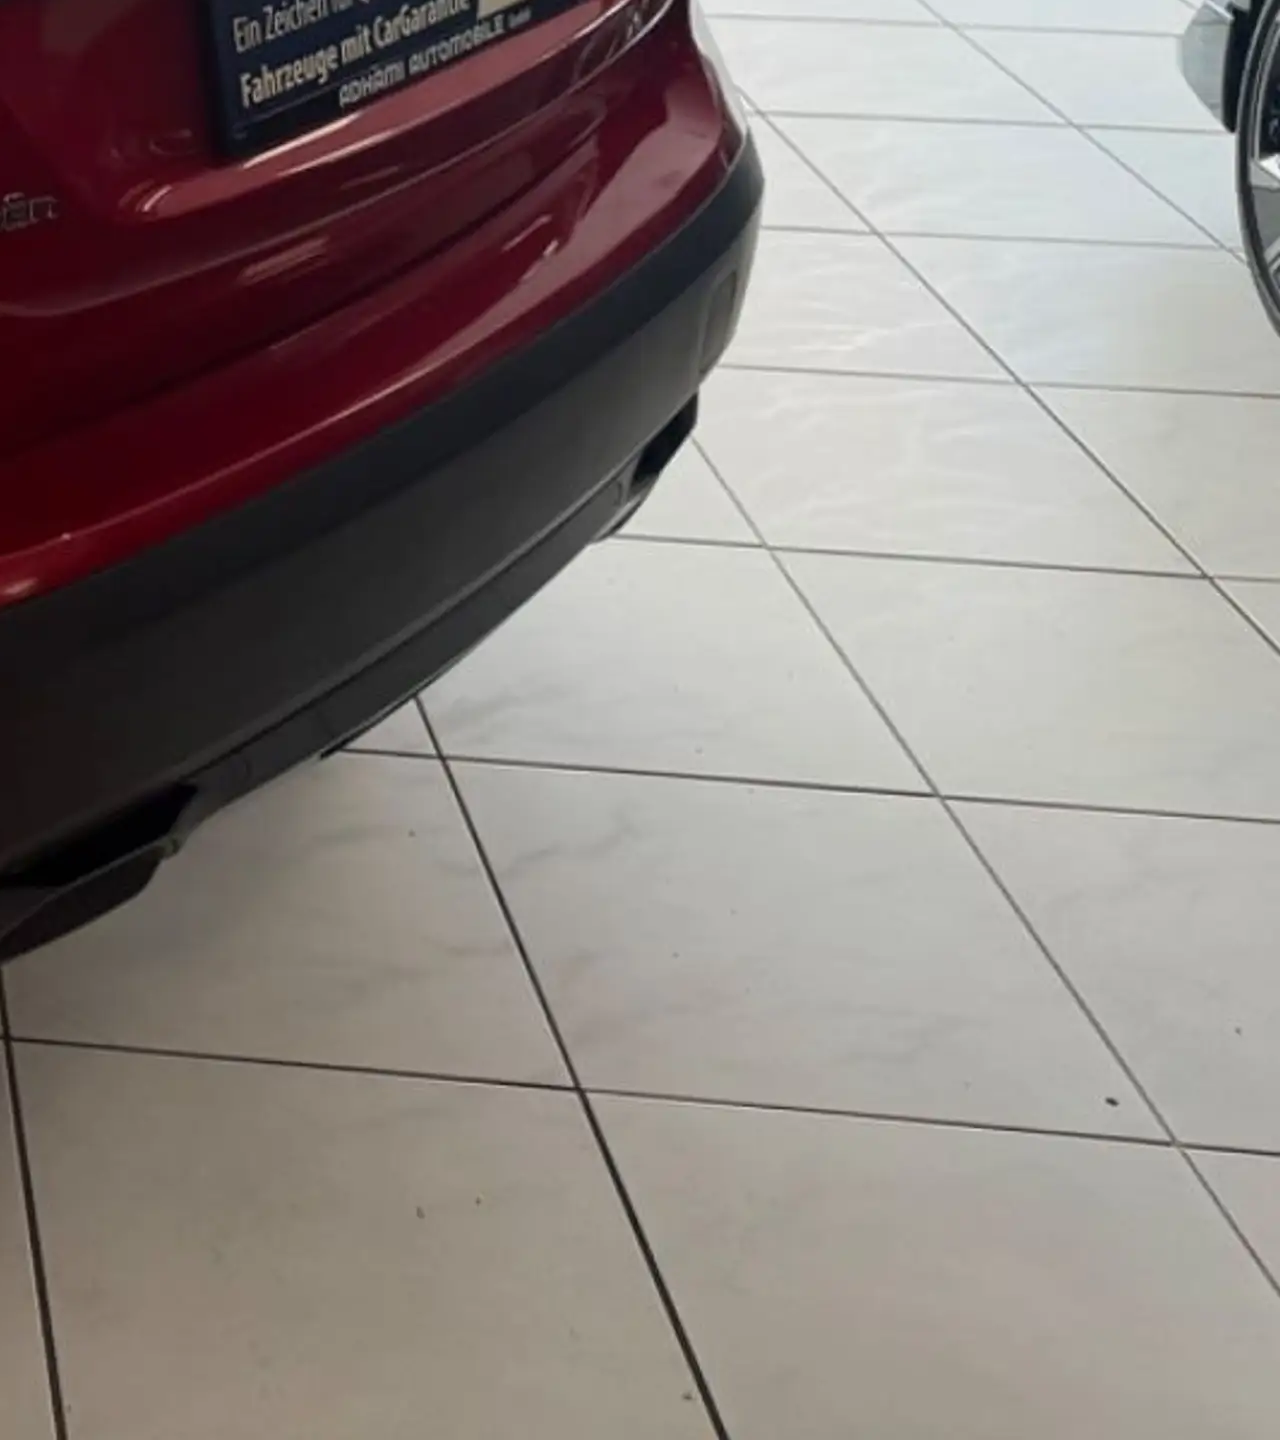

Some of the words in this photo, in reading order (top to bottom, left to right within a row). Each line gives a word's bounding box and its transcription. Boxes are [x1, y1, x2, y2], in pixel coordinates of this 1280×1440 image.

[233, 16, 261, 53] Ein
[407, 14, 505, 75] AUTOMOBILE
[240, 44, 338, 107] Fahrzeuge
[340, 25, 371, 62] mit
